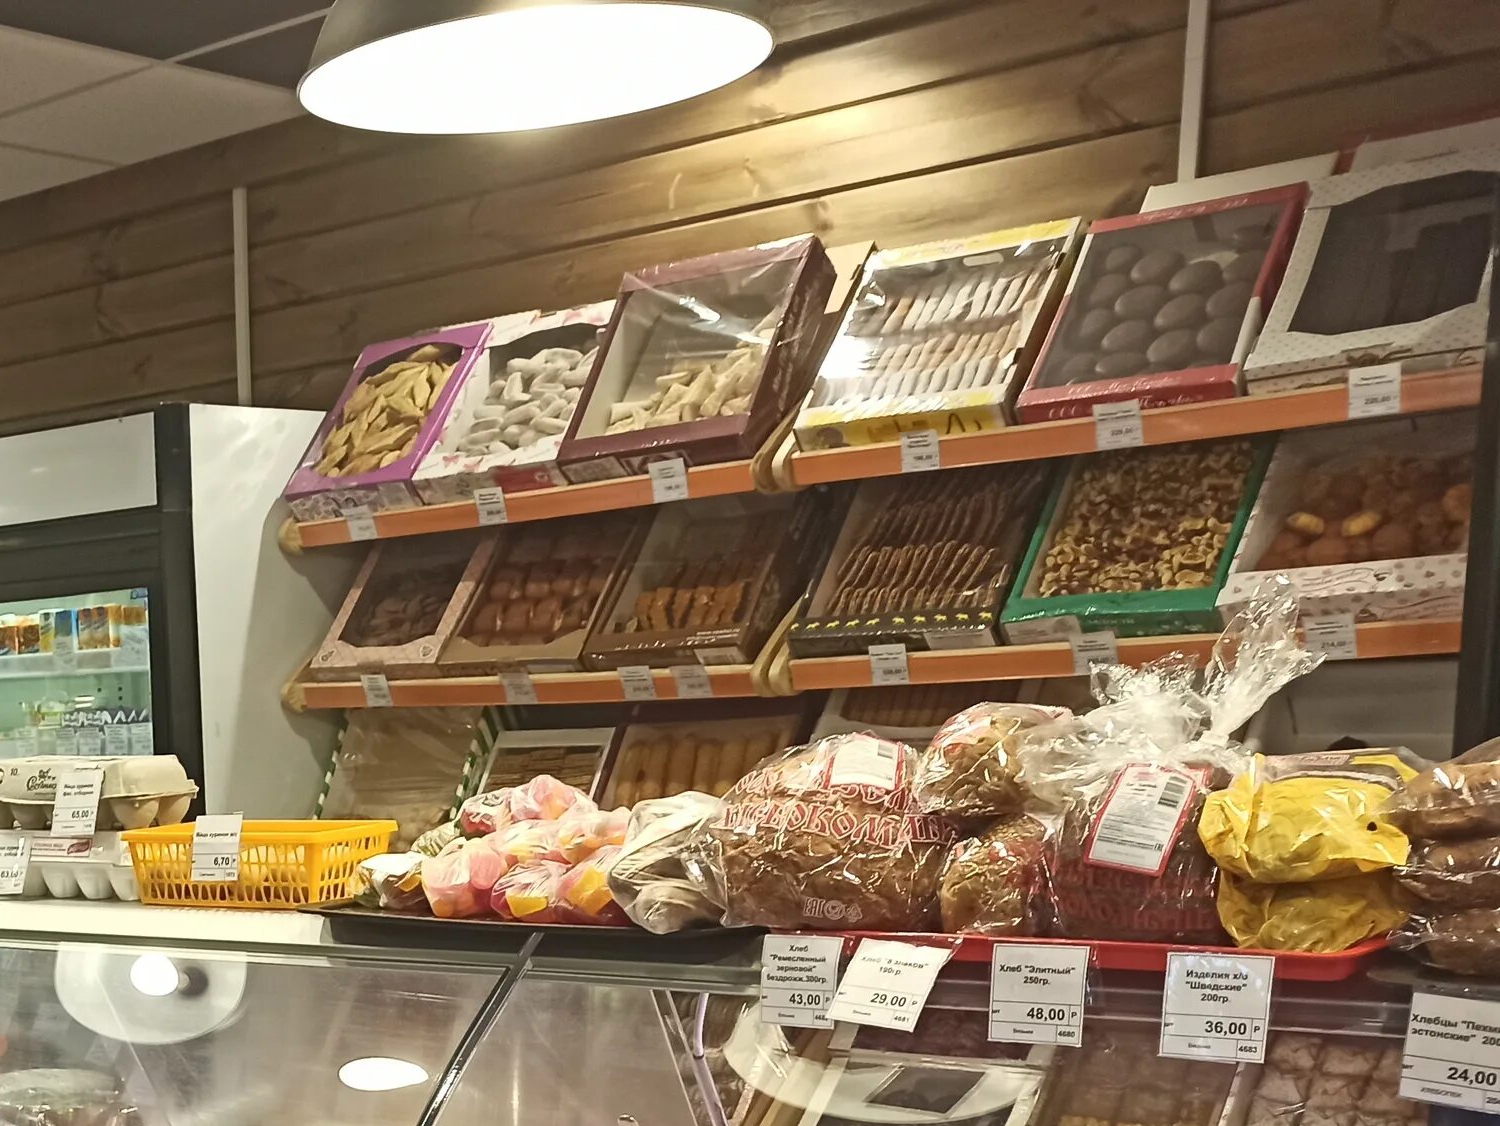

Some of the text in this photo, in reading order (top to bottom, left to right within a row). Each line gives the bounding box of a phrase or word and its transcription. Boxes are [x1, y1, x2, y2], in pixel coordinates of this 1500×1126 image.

[1000, 964, 1076, 975] Хлеб "Элитный"
[1186, 970, 1230, 980] Изделия
[1185, 981, 1248, 992] "Шведские"
[789, 993, 821, 1006] 43,00
[870, 993, 906, 1007] 29,00
[1027, 1007, 1065, 1021] 48,00
[1411, 1013, 1458, 1028] Хлебцы
[1204, 1020, 1247, 1036] 36,00
[1411, 1028, 1476, 1042] эстонские"
[1447, 1067, 1497, 1086] 24,00
